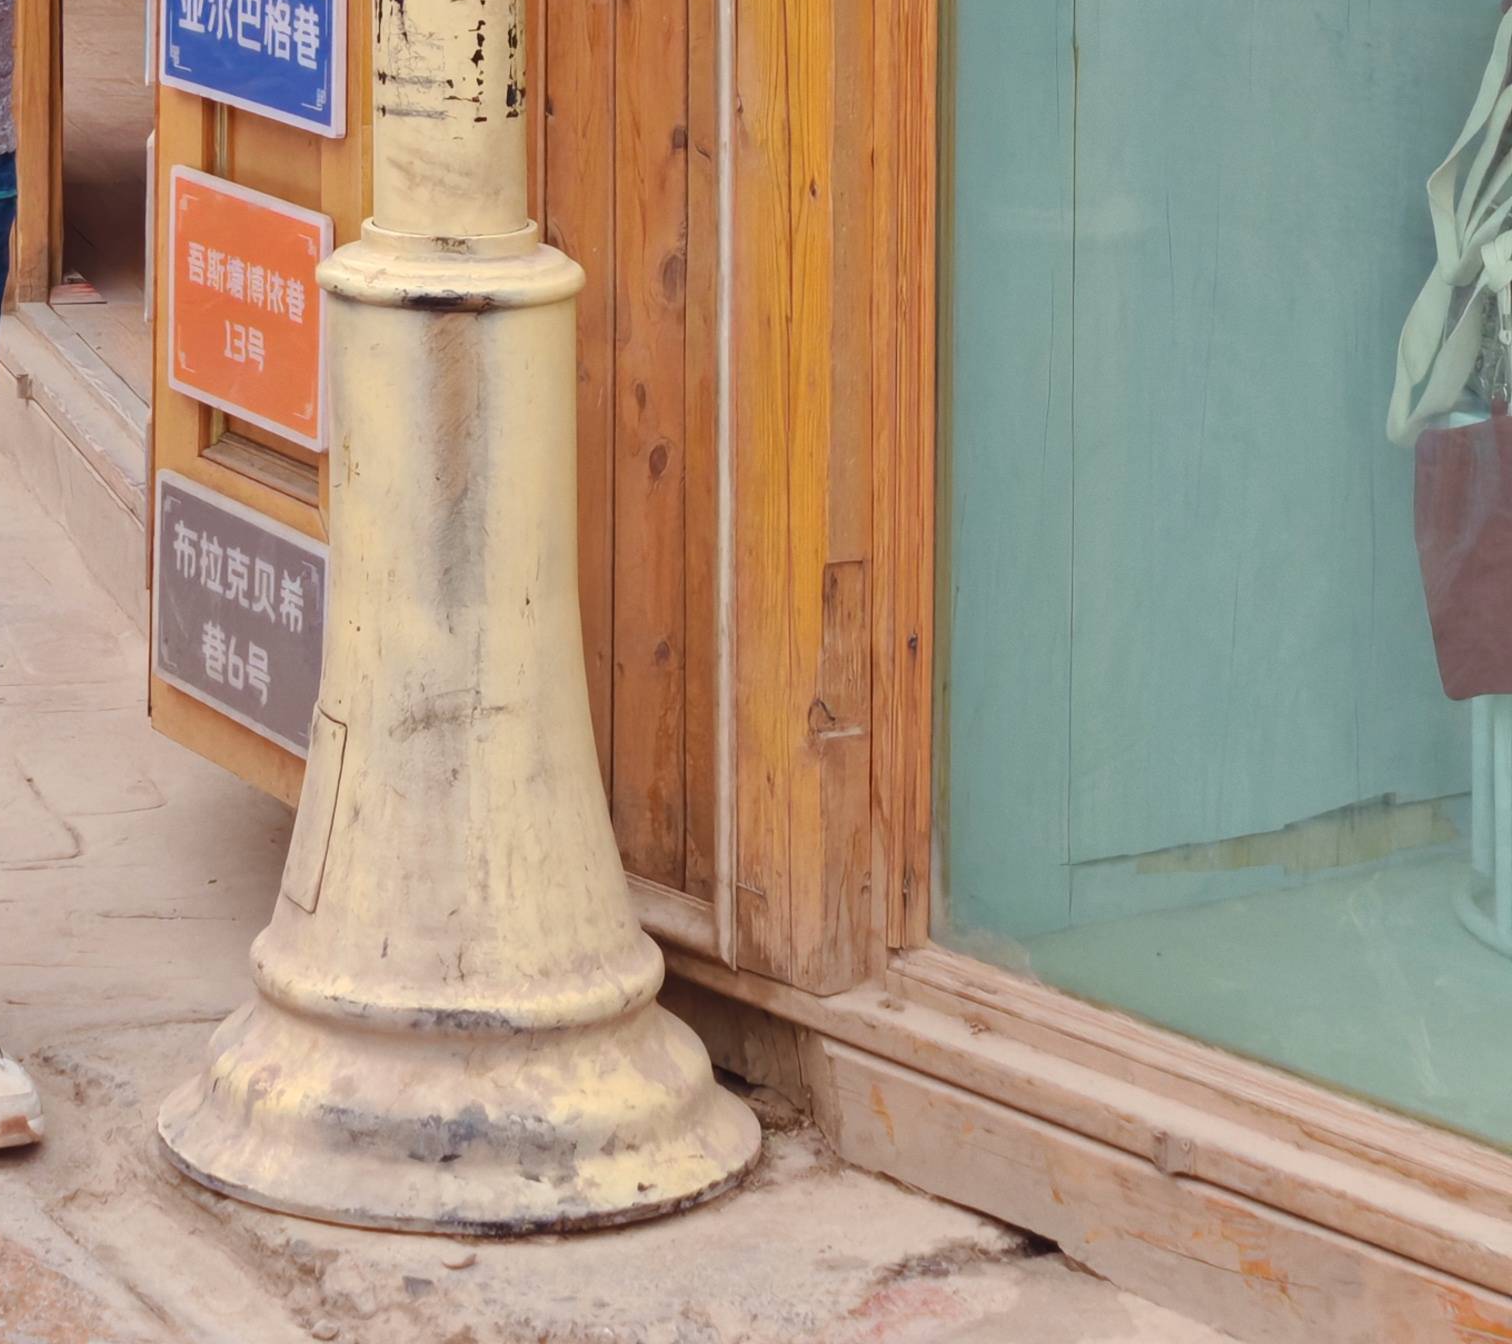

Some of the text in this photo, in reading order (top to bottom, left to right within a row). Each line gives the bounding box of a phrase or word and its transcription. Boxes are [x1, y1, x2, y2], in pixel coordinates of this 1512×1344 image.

[222, 318, 266, 374] 13号
[172, 519, 305, 634] 布拉克贝希
[201, 618, 272, 707] 巷6号
